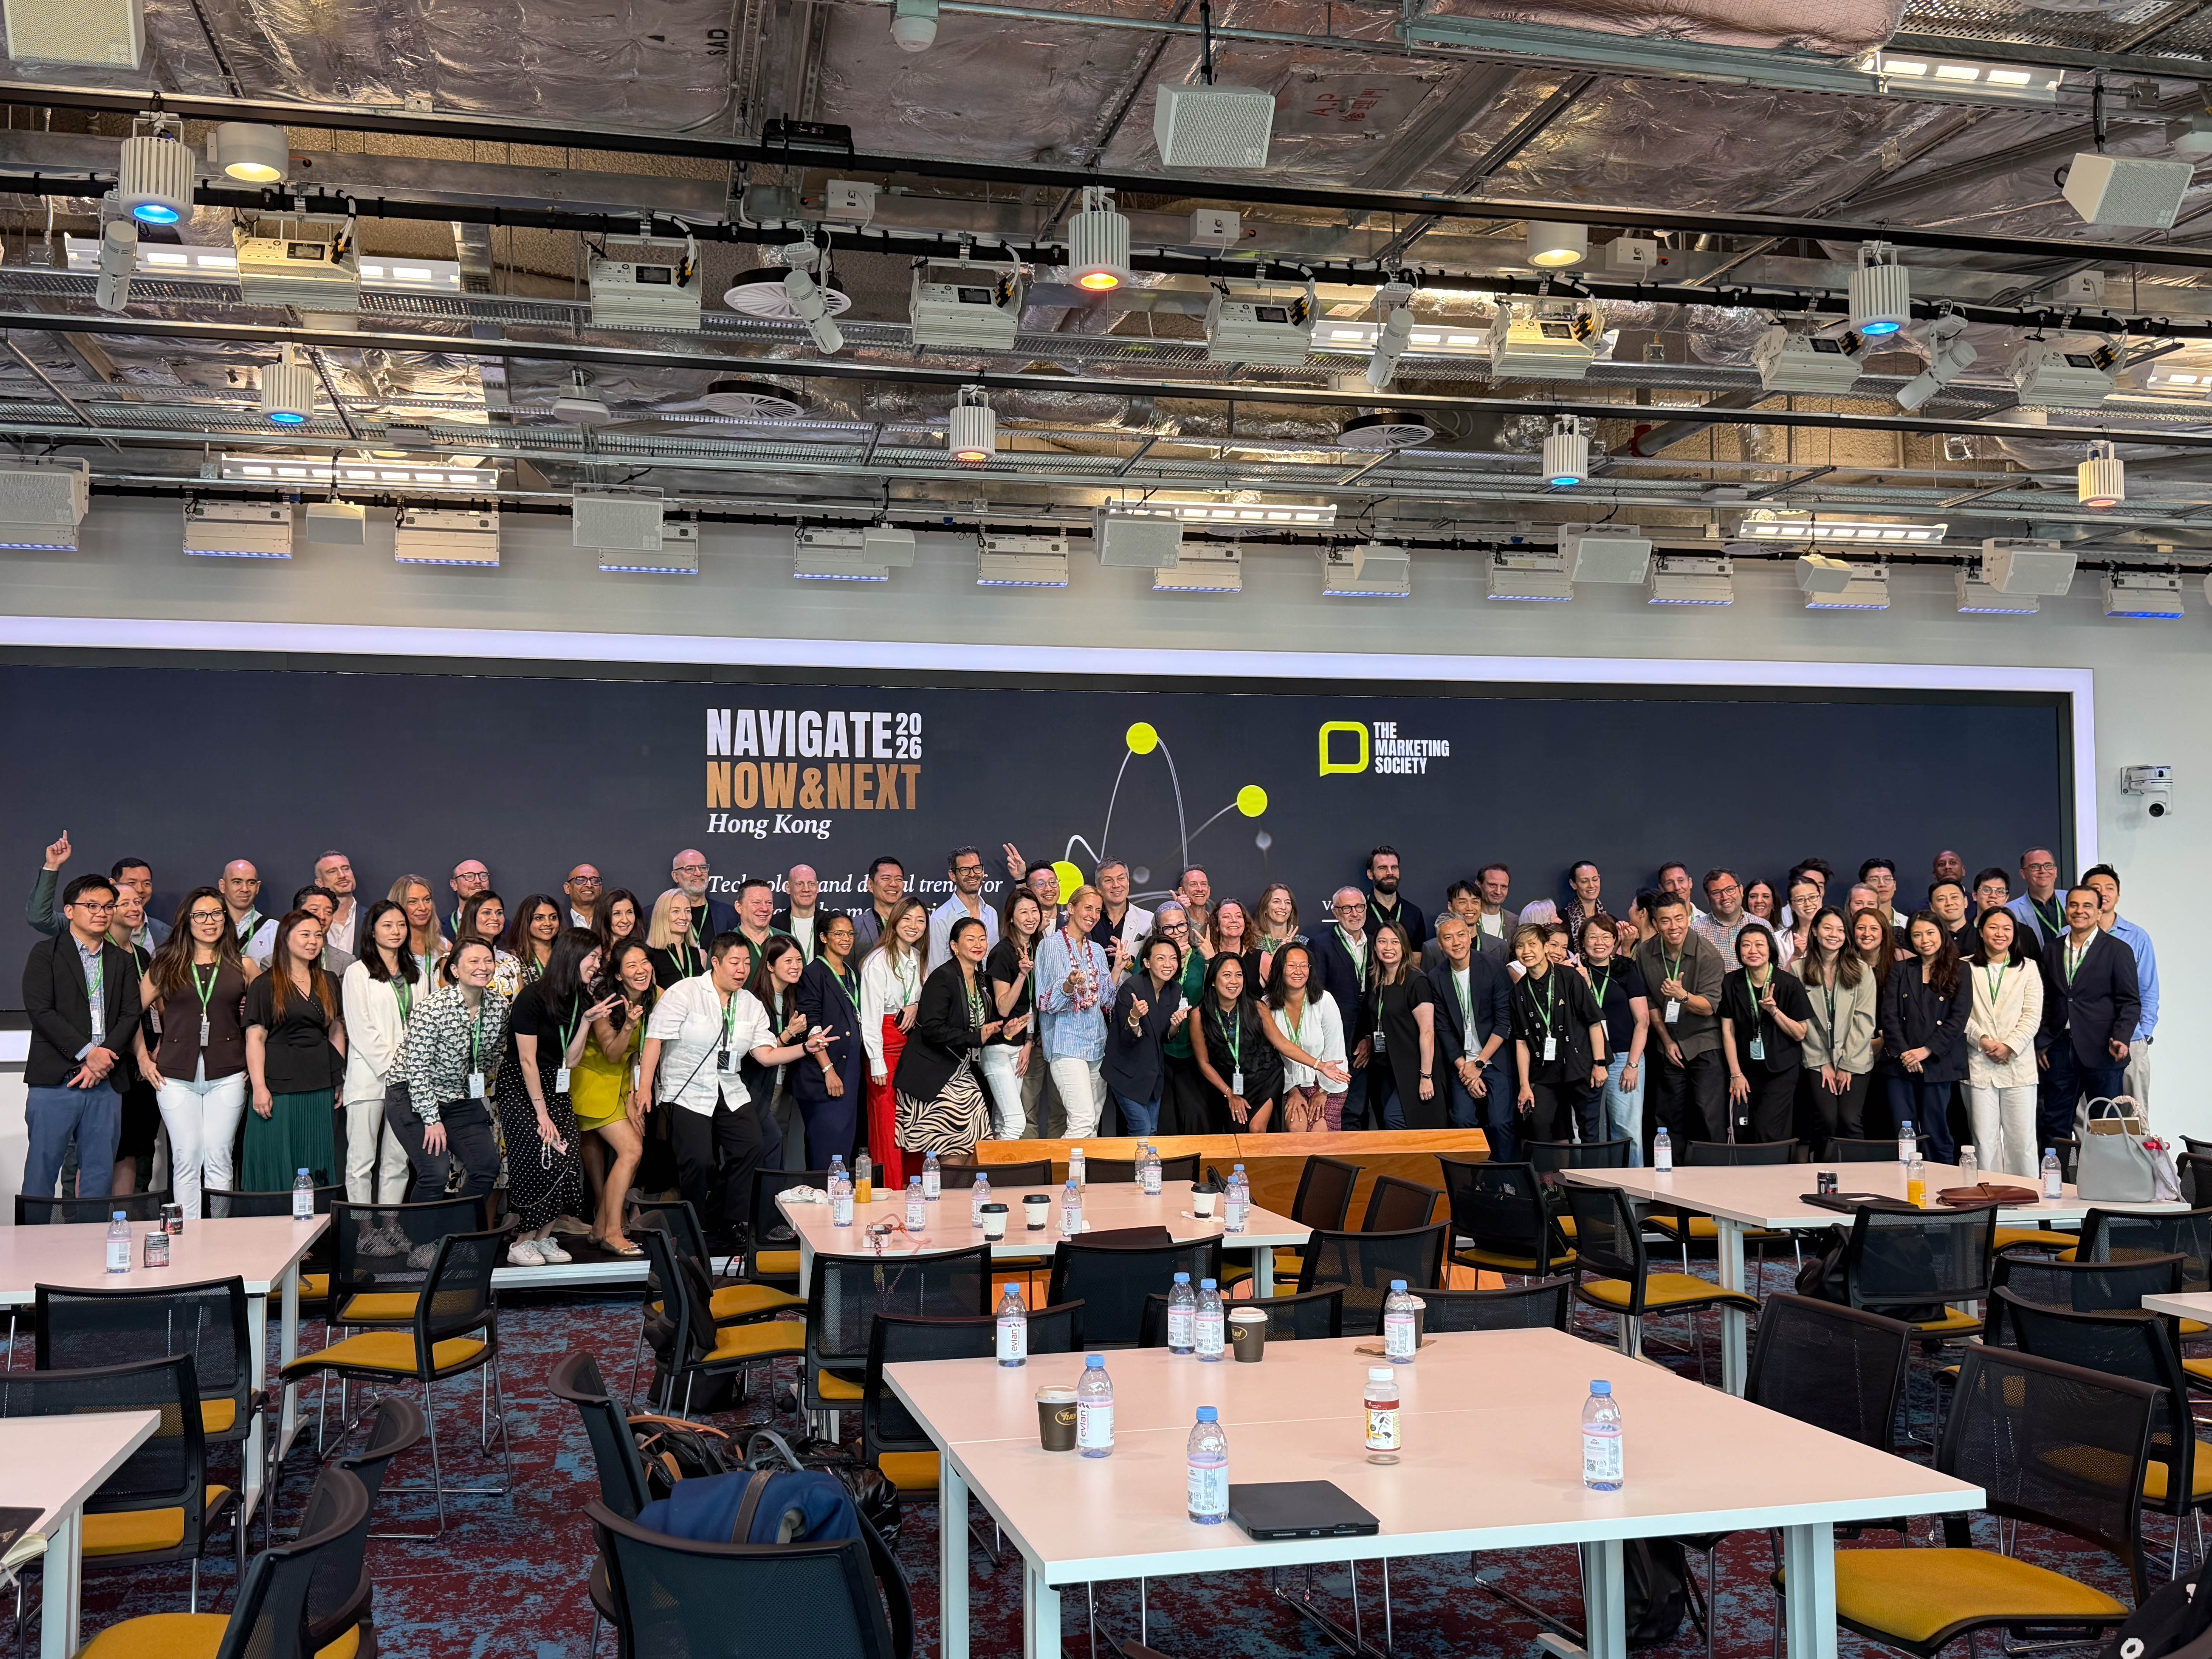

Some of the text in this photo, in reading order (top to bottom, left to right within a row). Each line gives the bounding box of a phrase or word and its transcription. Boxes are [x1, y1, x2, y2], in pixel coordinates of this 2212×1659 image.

[705, 29, 728, 55] SAD
[707, 708, 893, 759] NAVIGATE
[896, 713, 922, 735] 20
[1373, 721, 1397, 739] THE
[896, 736, 922, 759] 26
[1375, 739, 1449, 757] MARKETING
[1375, 757, 1427, 774] SOCIETY
[707, 761, 921, 810] NOW&NEXT
[707, 814, 832, 840] Hong Kong
[819, 874, 852, 893] and
[920, 879, 957, 893] tren
[1062, 1412, 1077, 1421] fue
